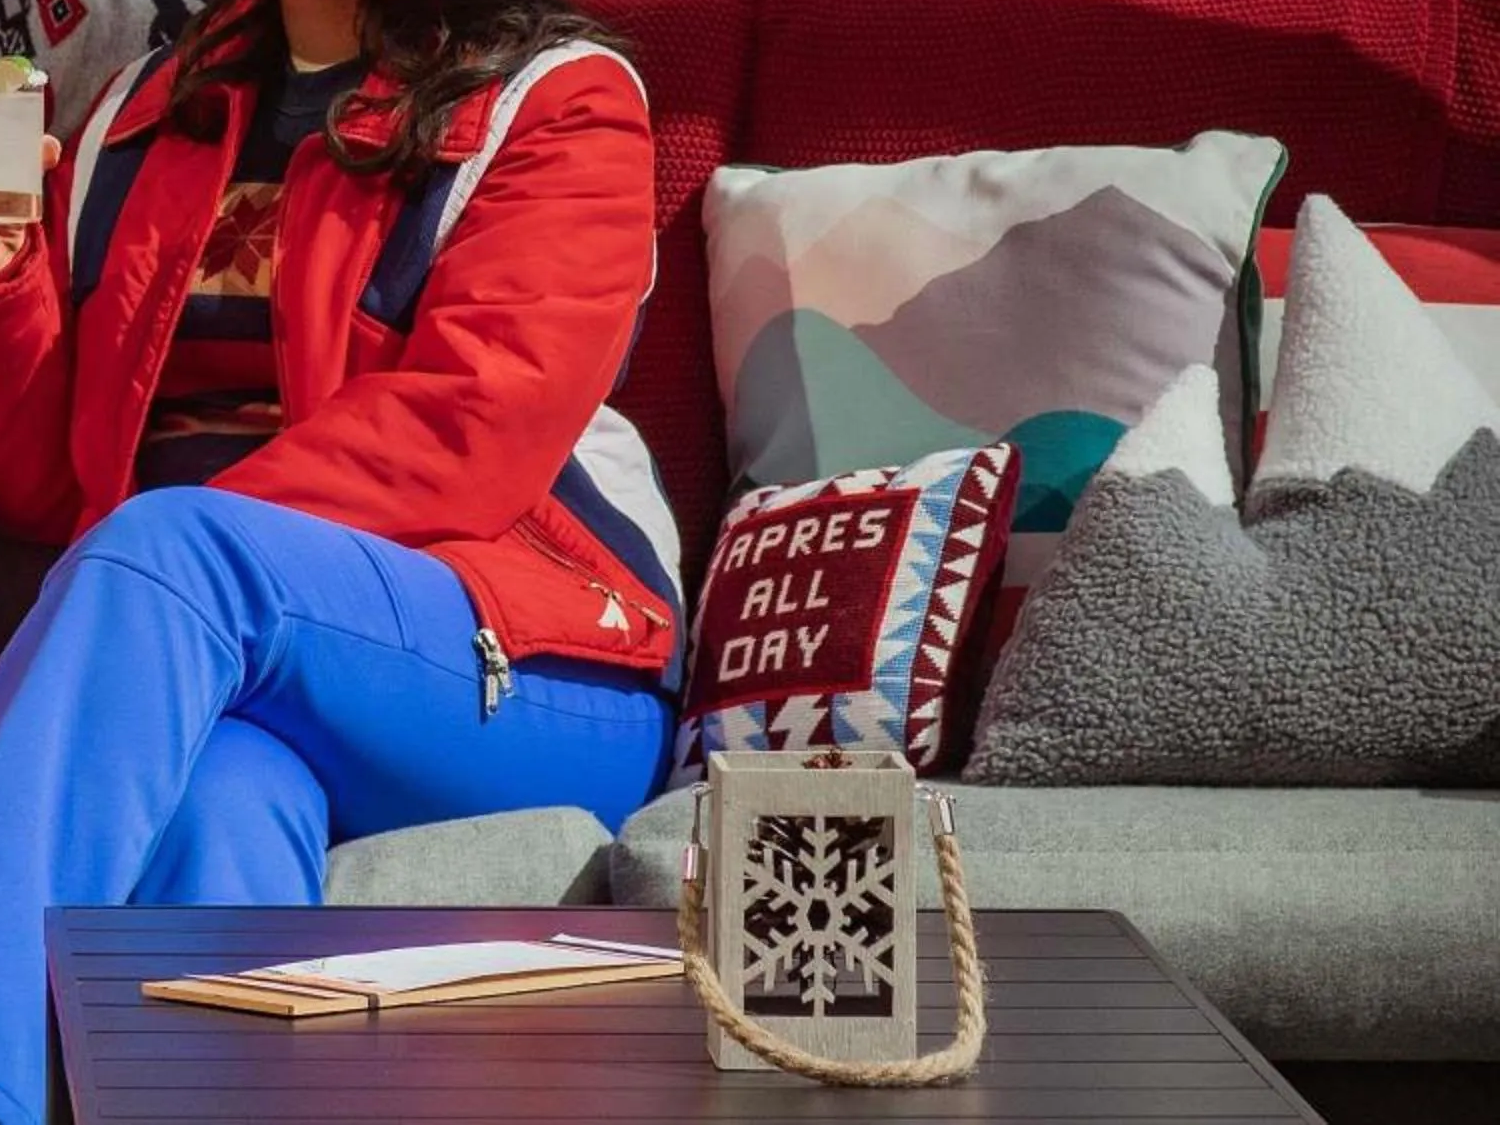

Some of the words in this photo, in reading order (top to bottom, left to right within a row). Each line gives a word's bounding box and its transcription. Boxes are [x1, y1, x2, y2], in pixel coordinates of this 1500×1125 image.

[724, 507, 892, 573] APRES
[740, 570, 830, 620] ALL
[717, 624, 830, 682] DAY
